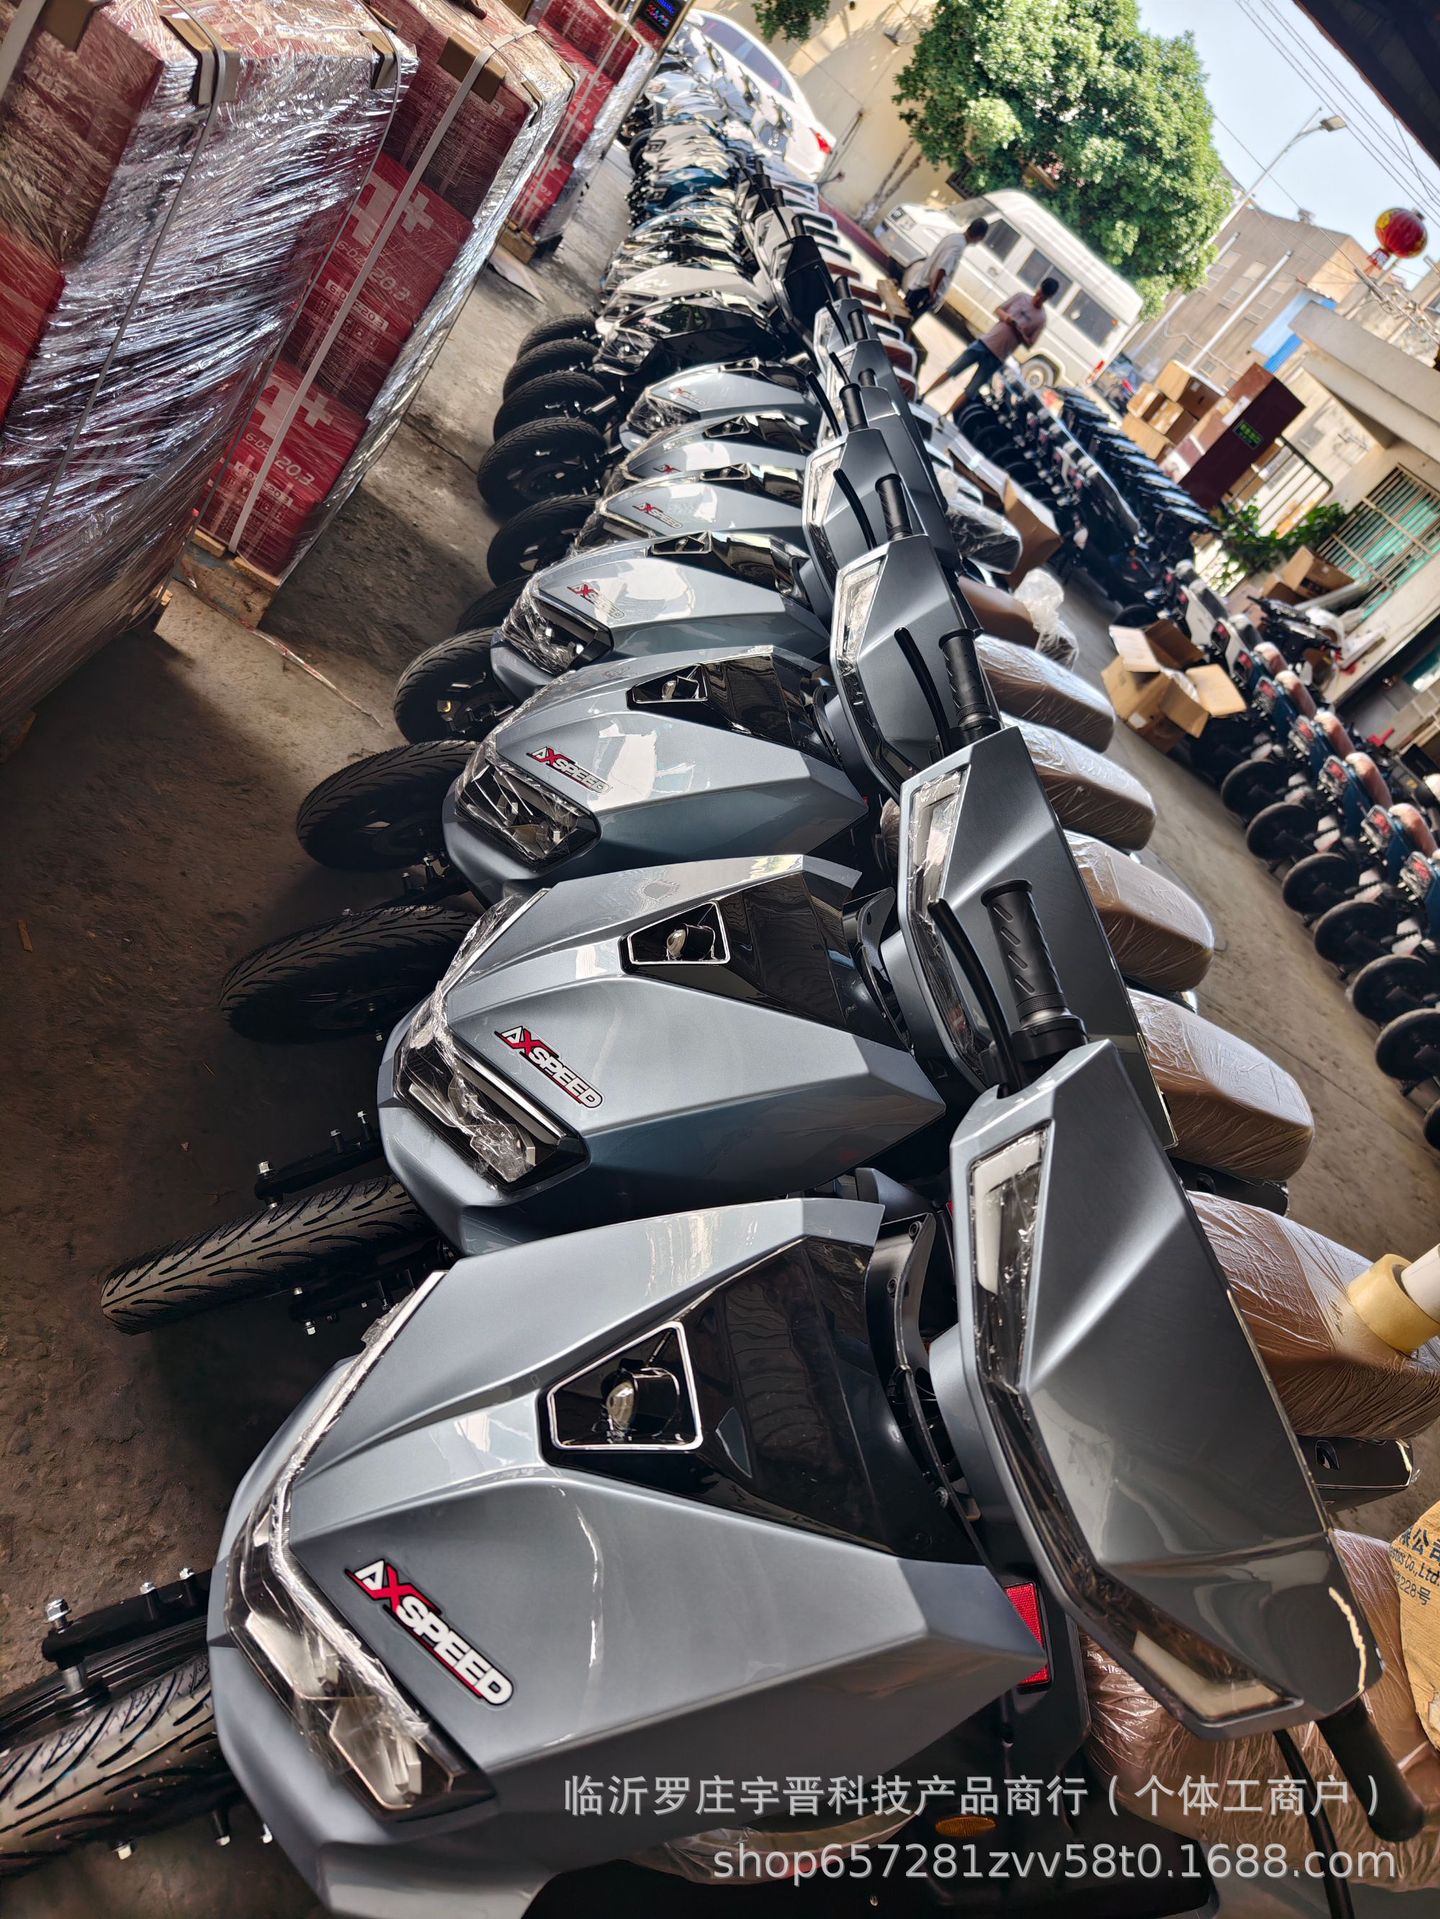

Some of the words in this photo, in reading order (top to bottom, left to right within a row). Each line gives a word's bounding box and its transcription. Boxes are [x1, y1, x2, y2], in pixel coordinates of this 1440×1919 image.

[526, 746, 612, 793] AXSPEED
[494, 1026, 603, 1108] AXSPEED
[344, 1558, 514, 1706] AXSPEED
